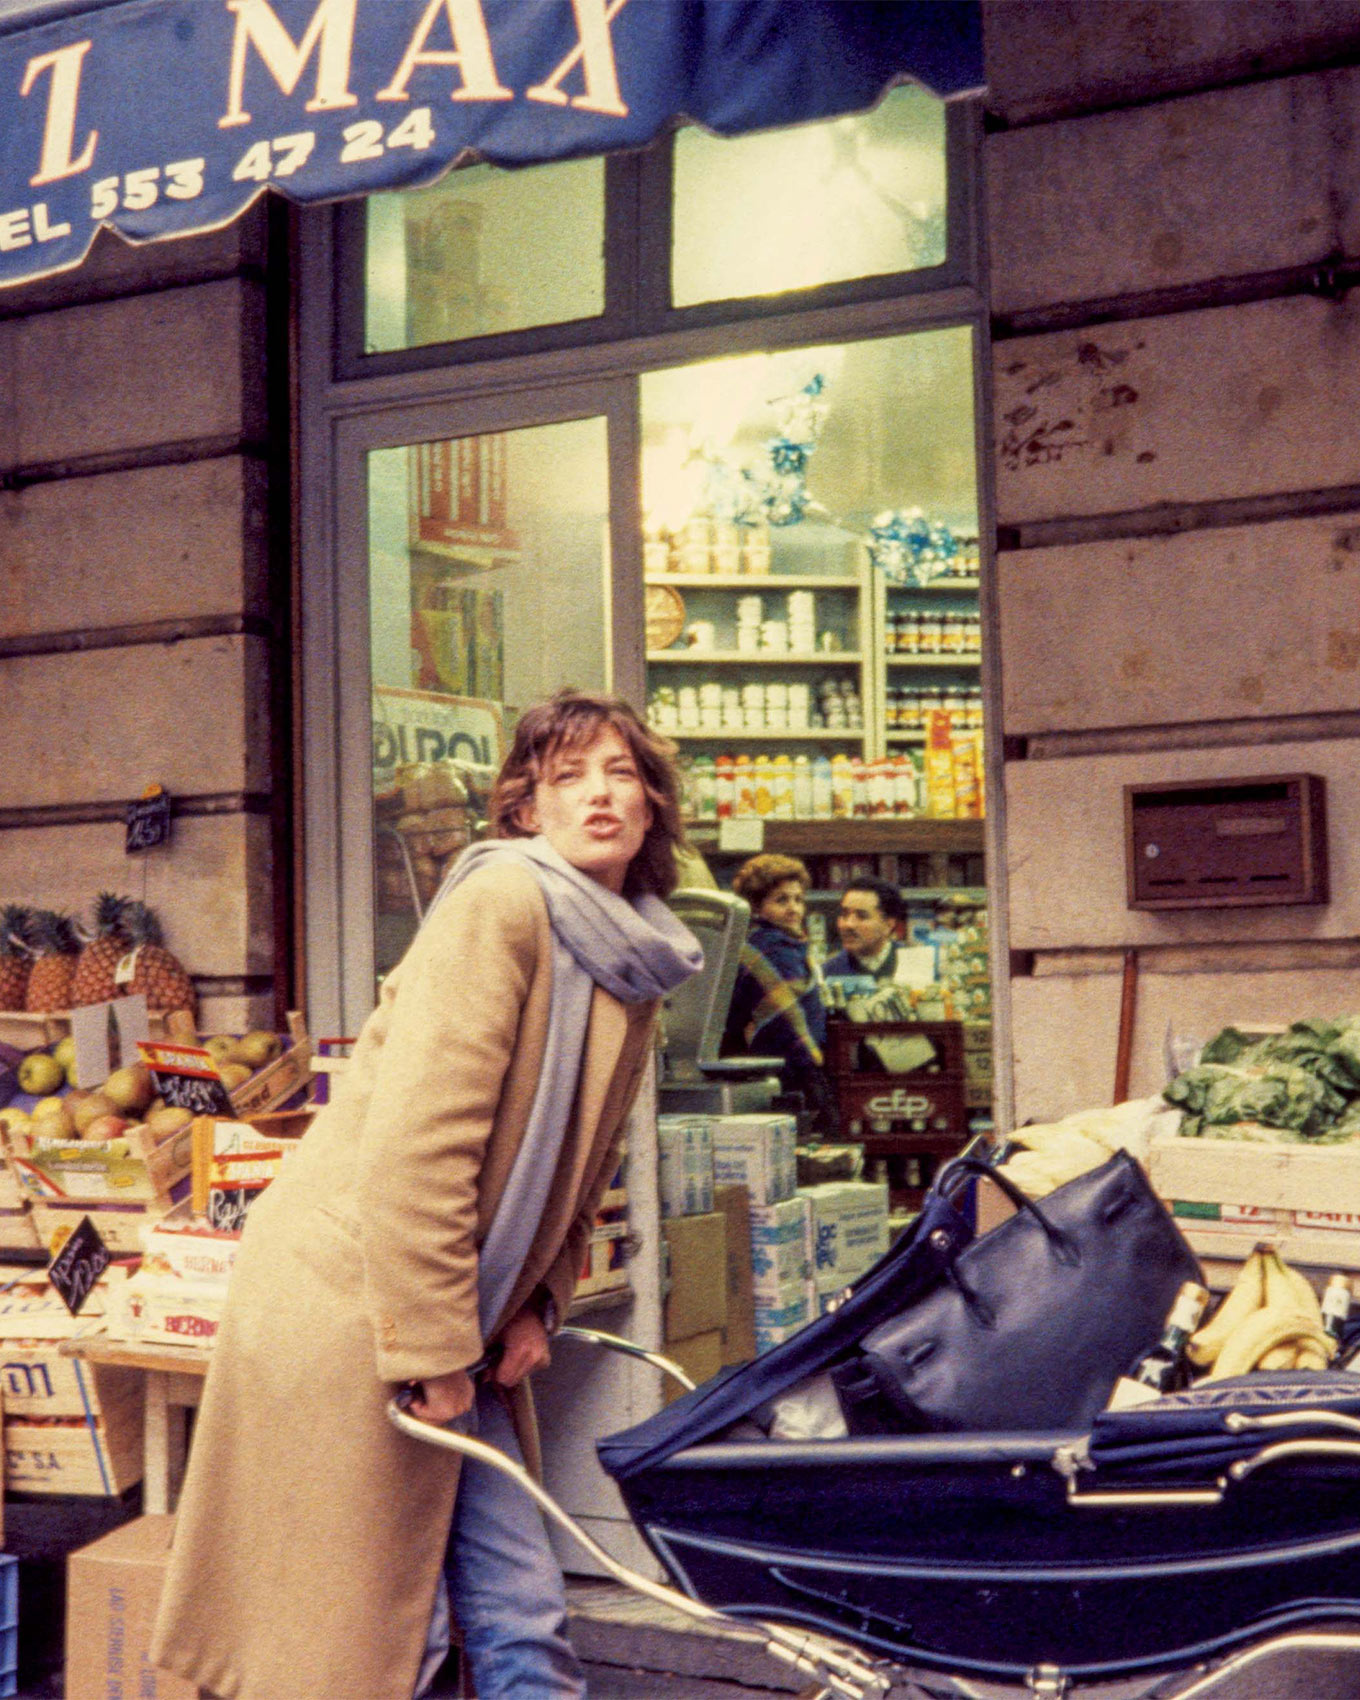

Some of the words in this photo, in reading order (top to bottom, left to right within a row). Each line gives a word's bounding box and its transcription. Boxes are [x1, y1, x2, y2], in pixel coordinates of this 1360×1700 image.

[217, 0, 629, 129] MAX
[90, 157, 206, 220] 553
[231, 130, 317, 182] 47
[338, 106, 436, 164] 24
